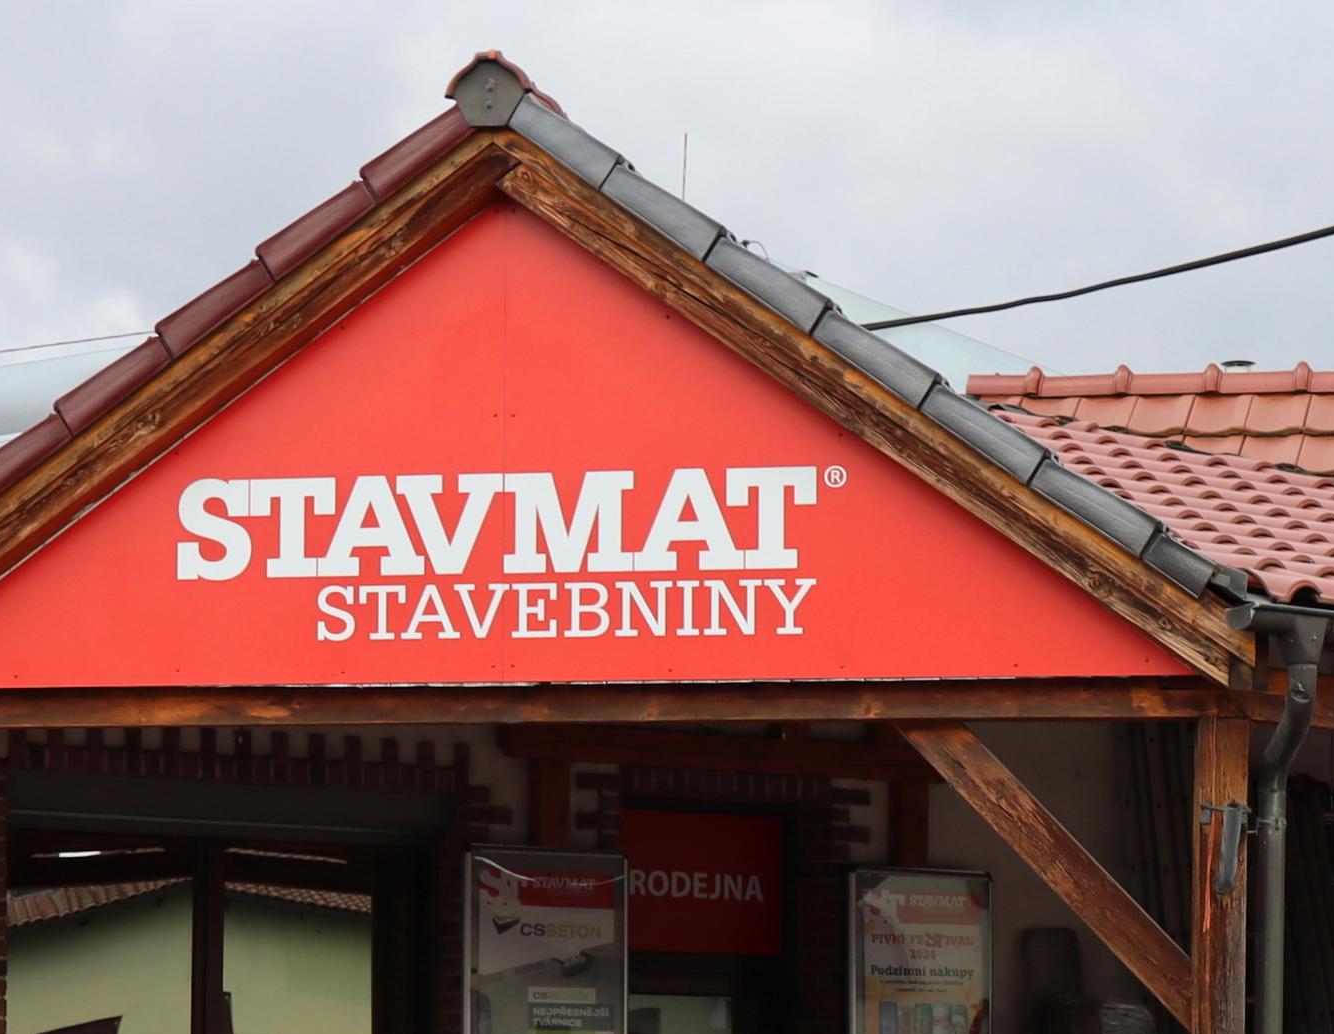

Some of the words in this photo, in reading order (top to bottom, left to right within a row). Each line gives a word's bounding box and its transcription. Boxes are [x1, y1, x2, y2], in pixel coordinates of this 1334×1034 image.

[315, 577, 817, 642] STAVEBNINY
[532, 876, 596, 890] STAVMAT
[629, 868, 764, 902] RODEJNA
[908, 894, 966, 908] STAVMAT
[870, 964, 926, 976] Podzimní
[929, 966, 975, 980] nákupy
